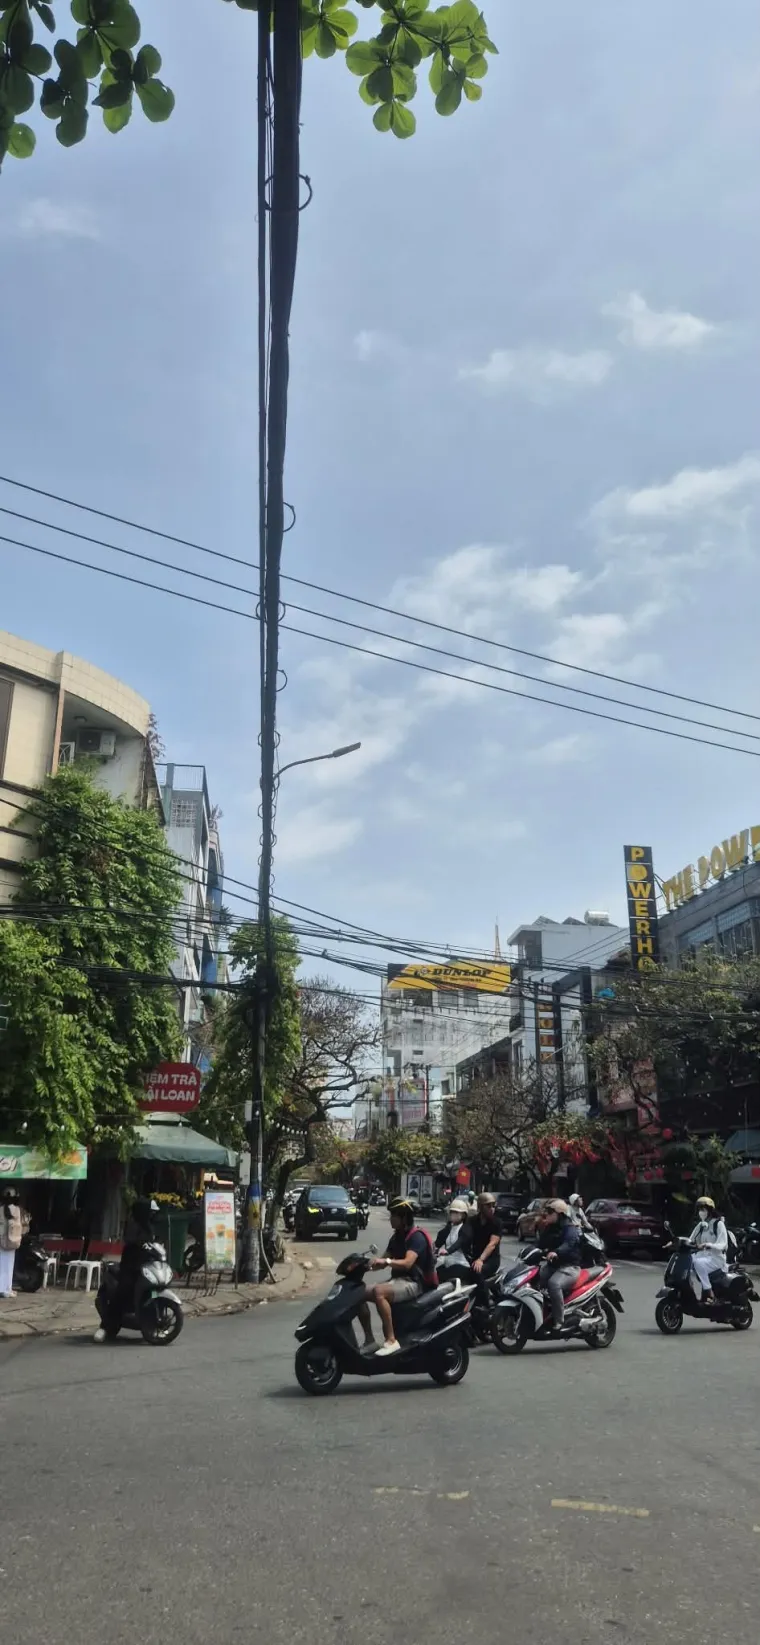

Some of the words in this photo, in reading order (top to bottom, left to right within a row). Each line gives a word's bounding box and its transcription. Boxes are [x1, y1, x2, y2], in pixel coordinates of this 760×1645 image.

[662, 864, 695, 911] THE
[433, 968, 491, 977] DUNLOP
[145, 1070, 169, 1085] IỆM
[171, 1072, 197, 1085] TRÀ
[145, 1085, 159, 1101] ÀI
[161, 1089, 196, 1101] LOAN
